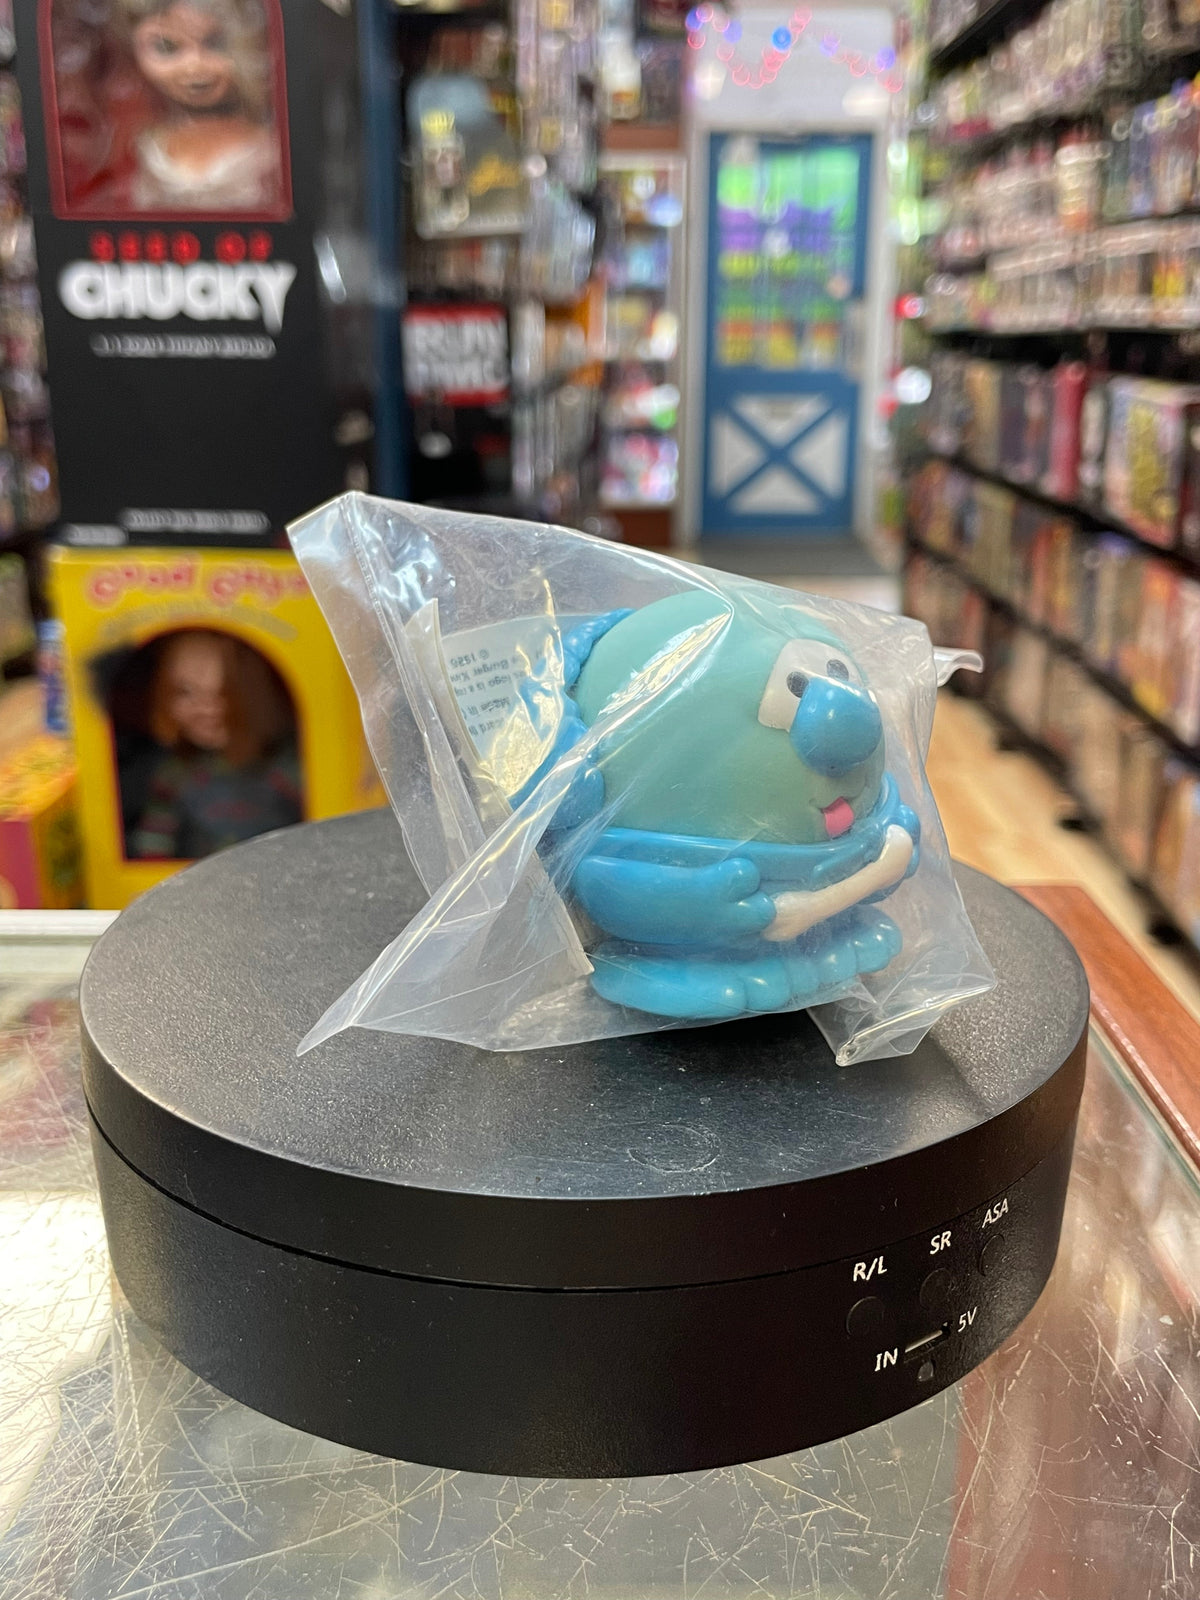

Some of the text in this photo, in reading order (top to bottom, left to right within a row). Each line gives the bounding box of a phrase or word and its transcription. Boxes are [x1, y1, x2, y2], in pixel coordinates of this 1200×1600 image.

[59, 260, 297, 334] CHUCKY
[982, 1198, 1009, 1229] ASA
[929, 1230, 952, 1255] SR
[852, 1255, 888, 1282] R/L
[957, 1306, 978, 1333] 5V
[874, 1348, 899, 1372] IN
